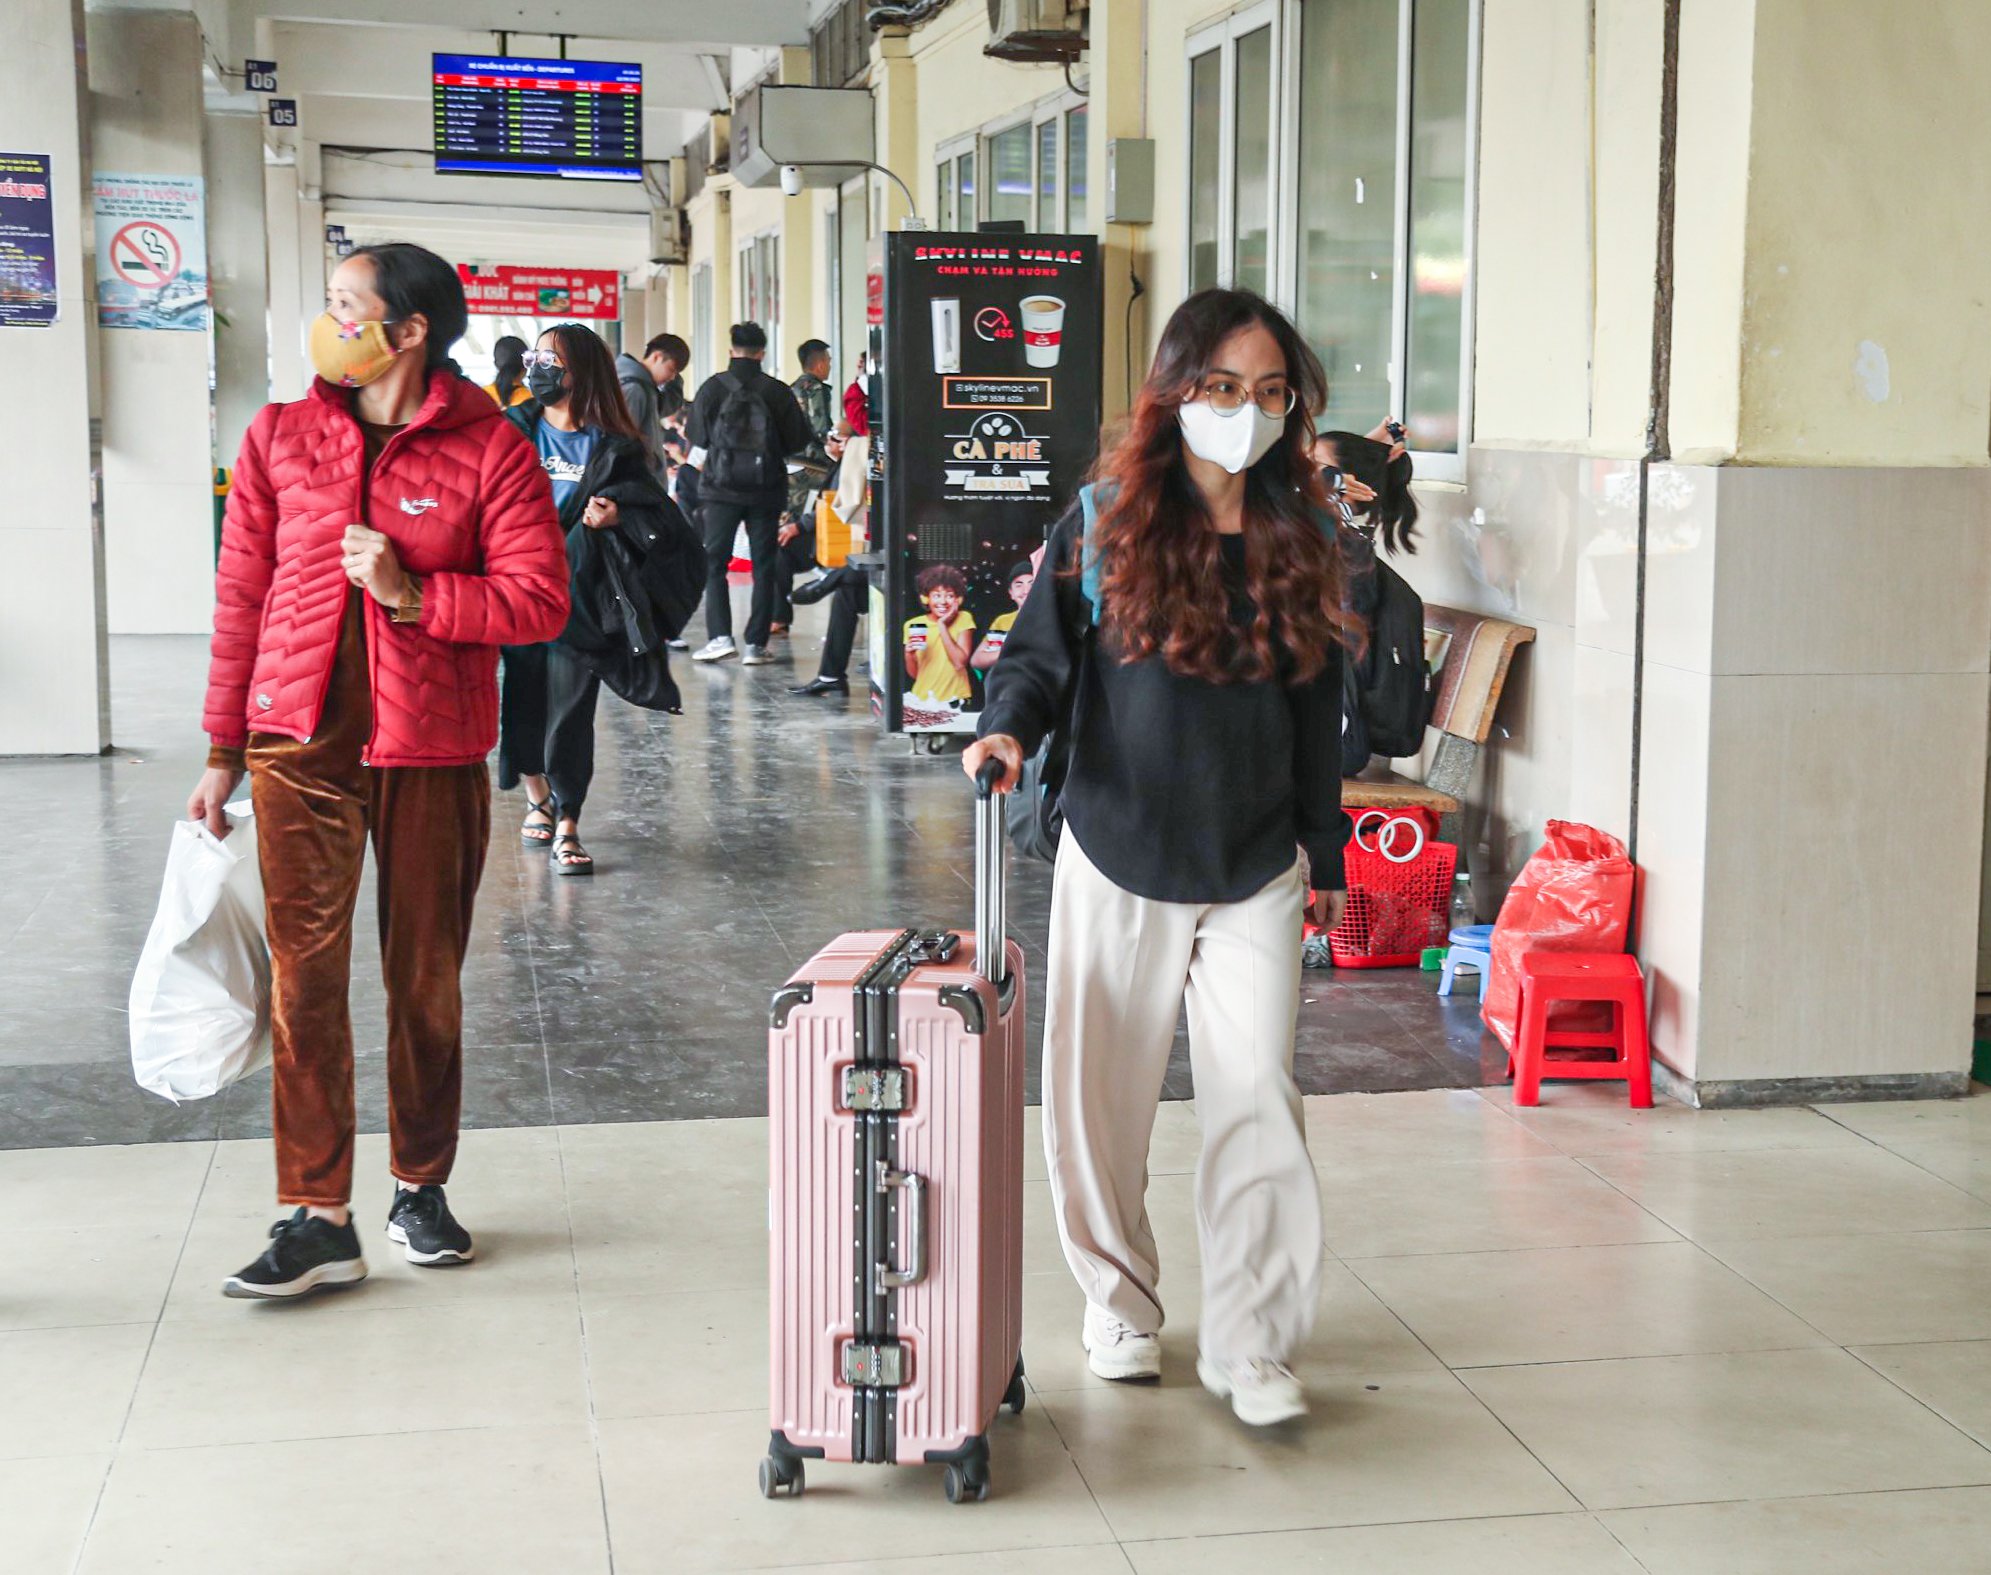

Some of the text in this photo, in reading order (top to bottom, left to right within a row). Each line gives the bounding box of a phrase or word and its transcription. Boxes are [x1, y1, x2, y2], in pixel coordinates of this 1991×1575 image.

[251, 72, 274, 89] 06
[273, 109, 295, 124] 05
[964, 384, 1040, 393] skylinevmac.vn
[952, 438, 1042, 460] CÀ PHÊ
[544, 456, 586, 475] Ange
[992, 464, 1003, 475] &
